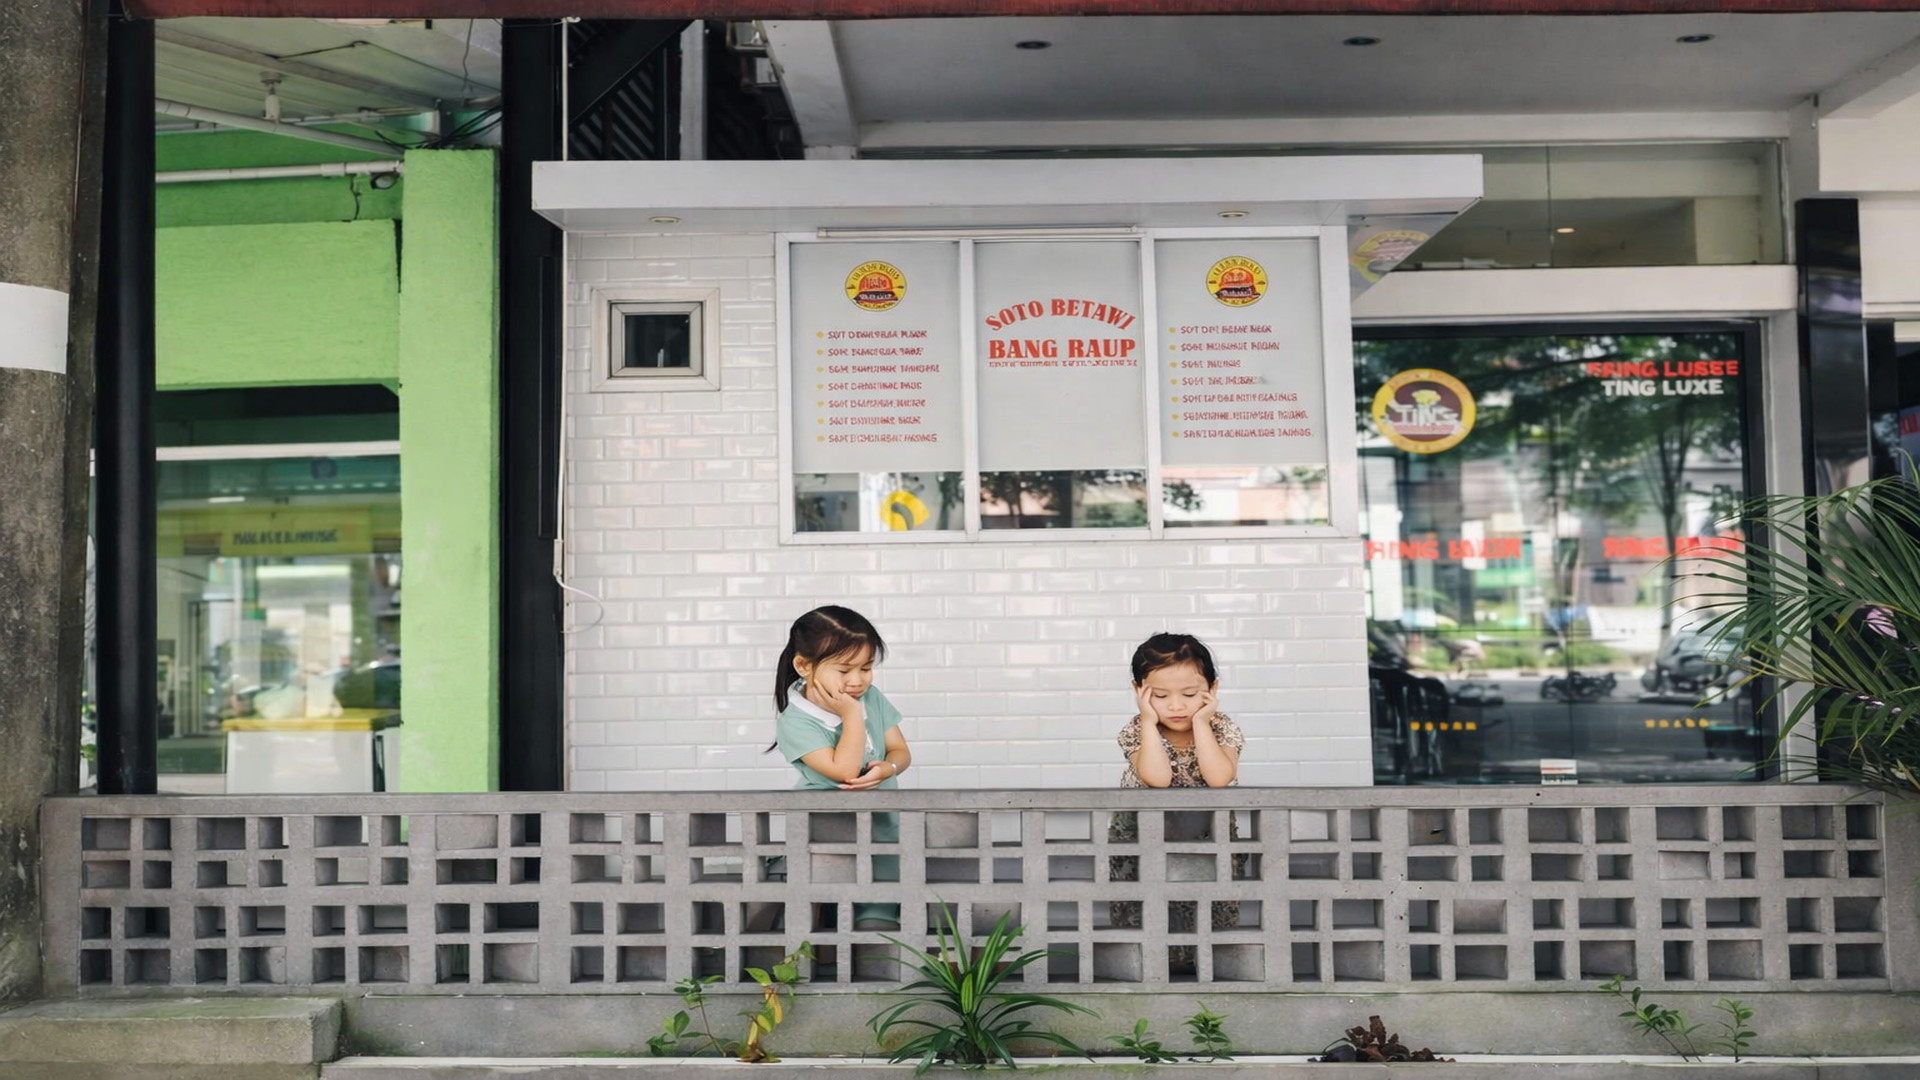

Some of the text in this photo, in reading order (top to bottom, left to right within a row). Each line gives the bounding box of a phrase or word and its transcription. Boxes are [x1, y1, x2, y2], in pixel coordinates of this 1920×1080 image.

[984, 298, 1136, 331] SOTO BETAWI
[988, 338, 1136, 359] BANG RAUP
[1601, 379, 1724, 396] TING LUXE
